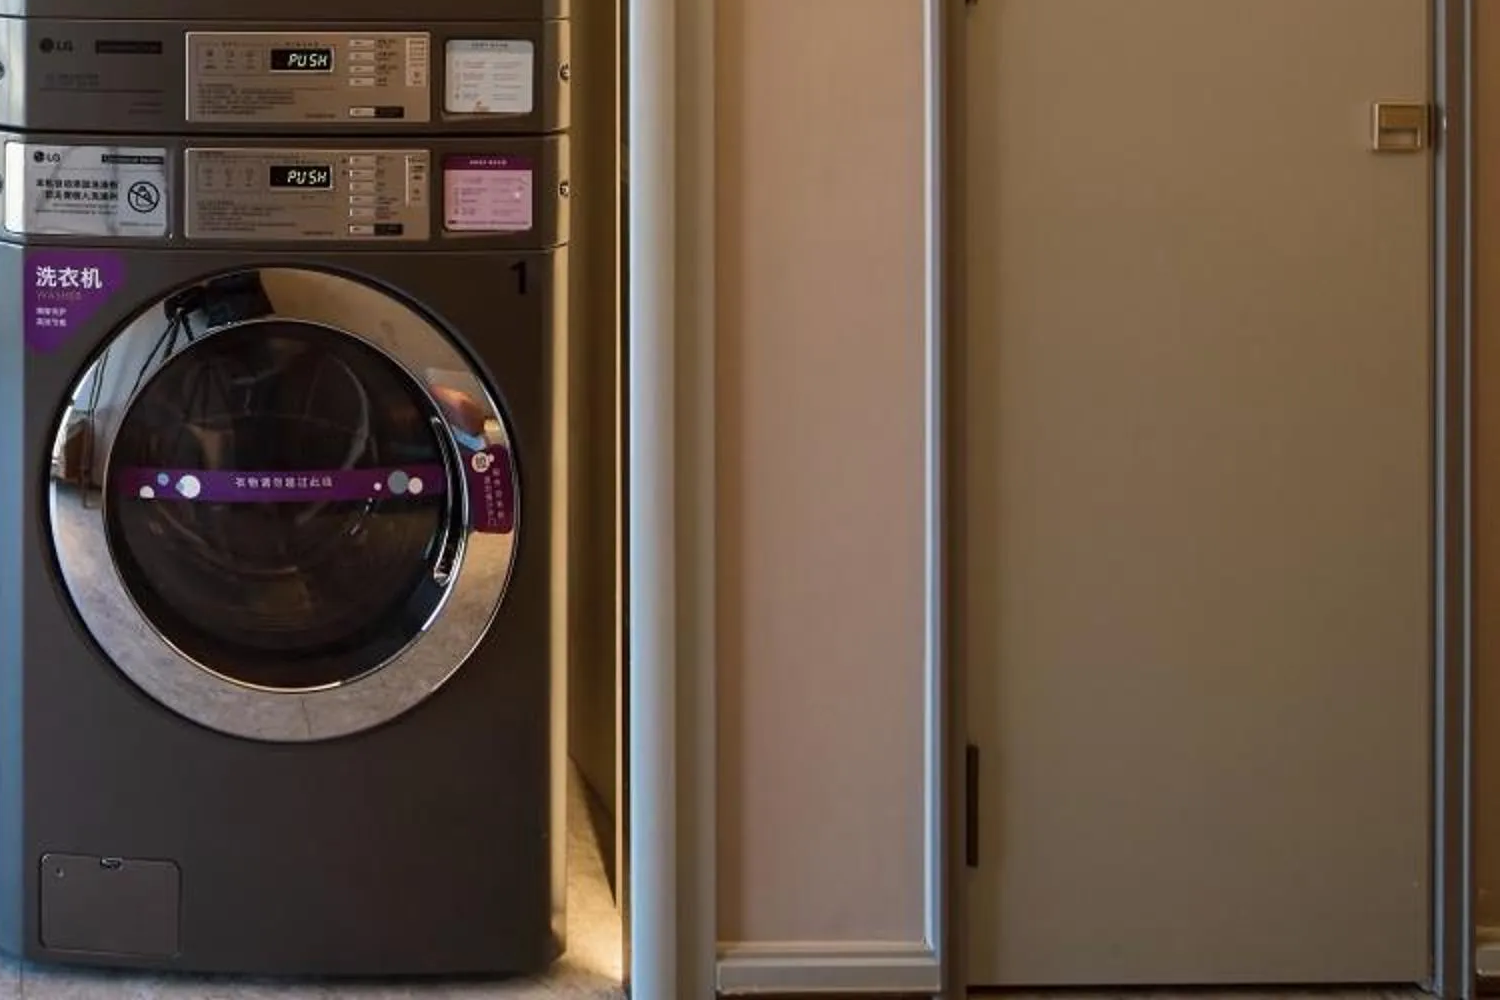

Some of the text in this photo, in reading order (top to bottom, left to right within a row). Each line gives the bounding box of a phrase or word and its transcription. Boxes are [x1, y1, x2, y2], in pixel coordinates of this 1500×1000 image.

[56, 39, 74, 52] LG
[287, 53, 328, 67] PUSH
[46, 152, 61, 163] LG
[287, 169, 327, 184] PUSH
[35, 265, 103, 290] 洗衣机
[509, 261, 528, 294] 1
